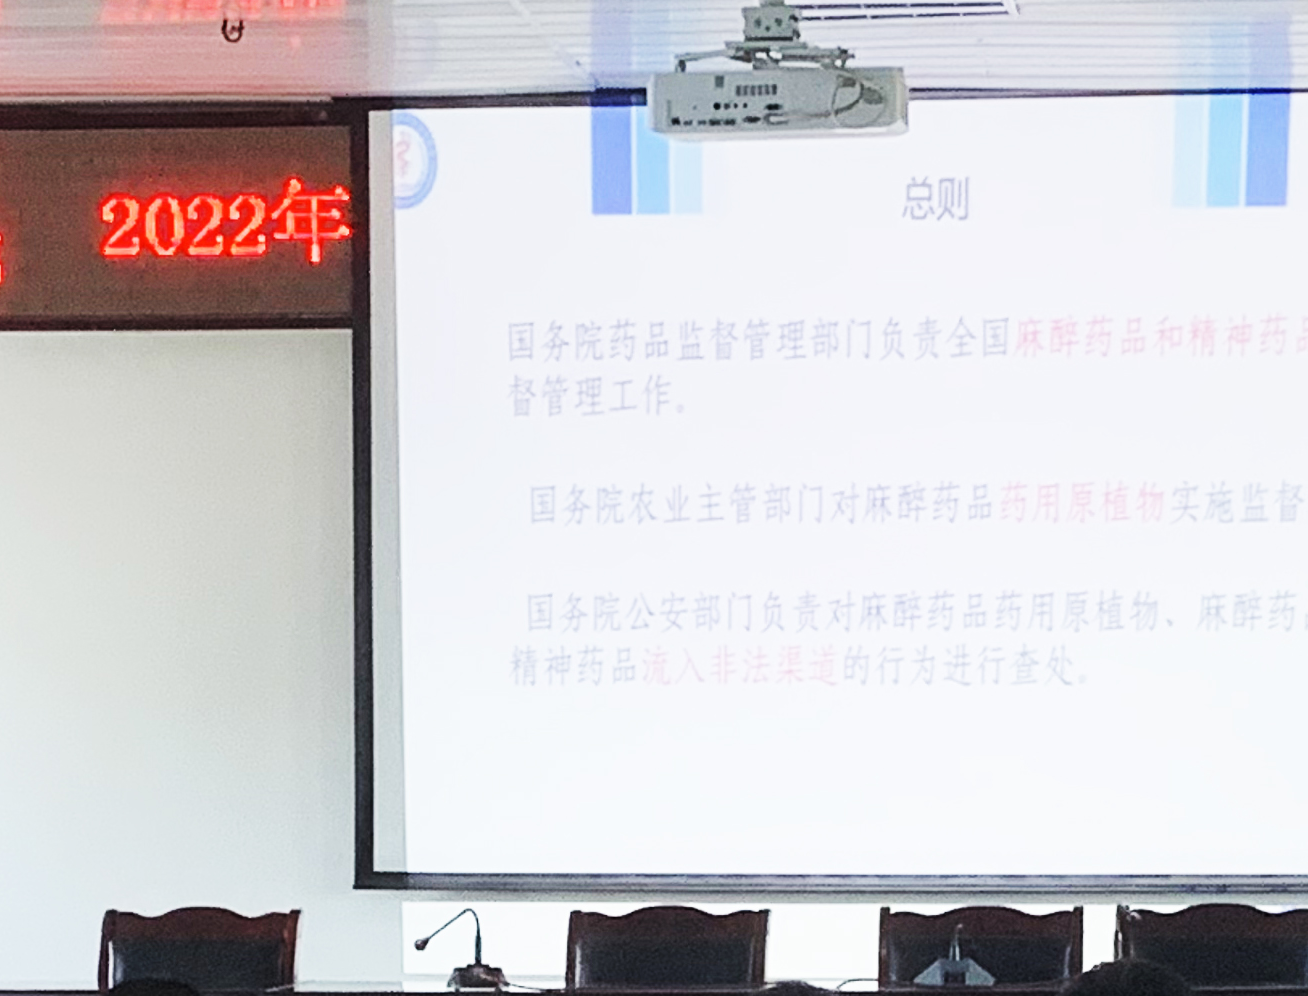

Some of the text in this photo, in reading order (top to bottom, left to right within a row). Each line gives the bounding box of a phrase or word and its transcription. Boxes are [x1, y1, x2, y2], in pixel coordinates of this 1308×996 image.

[100, 176, 350, 263] 2022年
[902, 176, 970, 221] 总则
[508, 374, 685, 417] 督管理工作。
[509, 643, 1088, 687] 精神药品流入非法渠道的行为进行查处。
